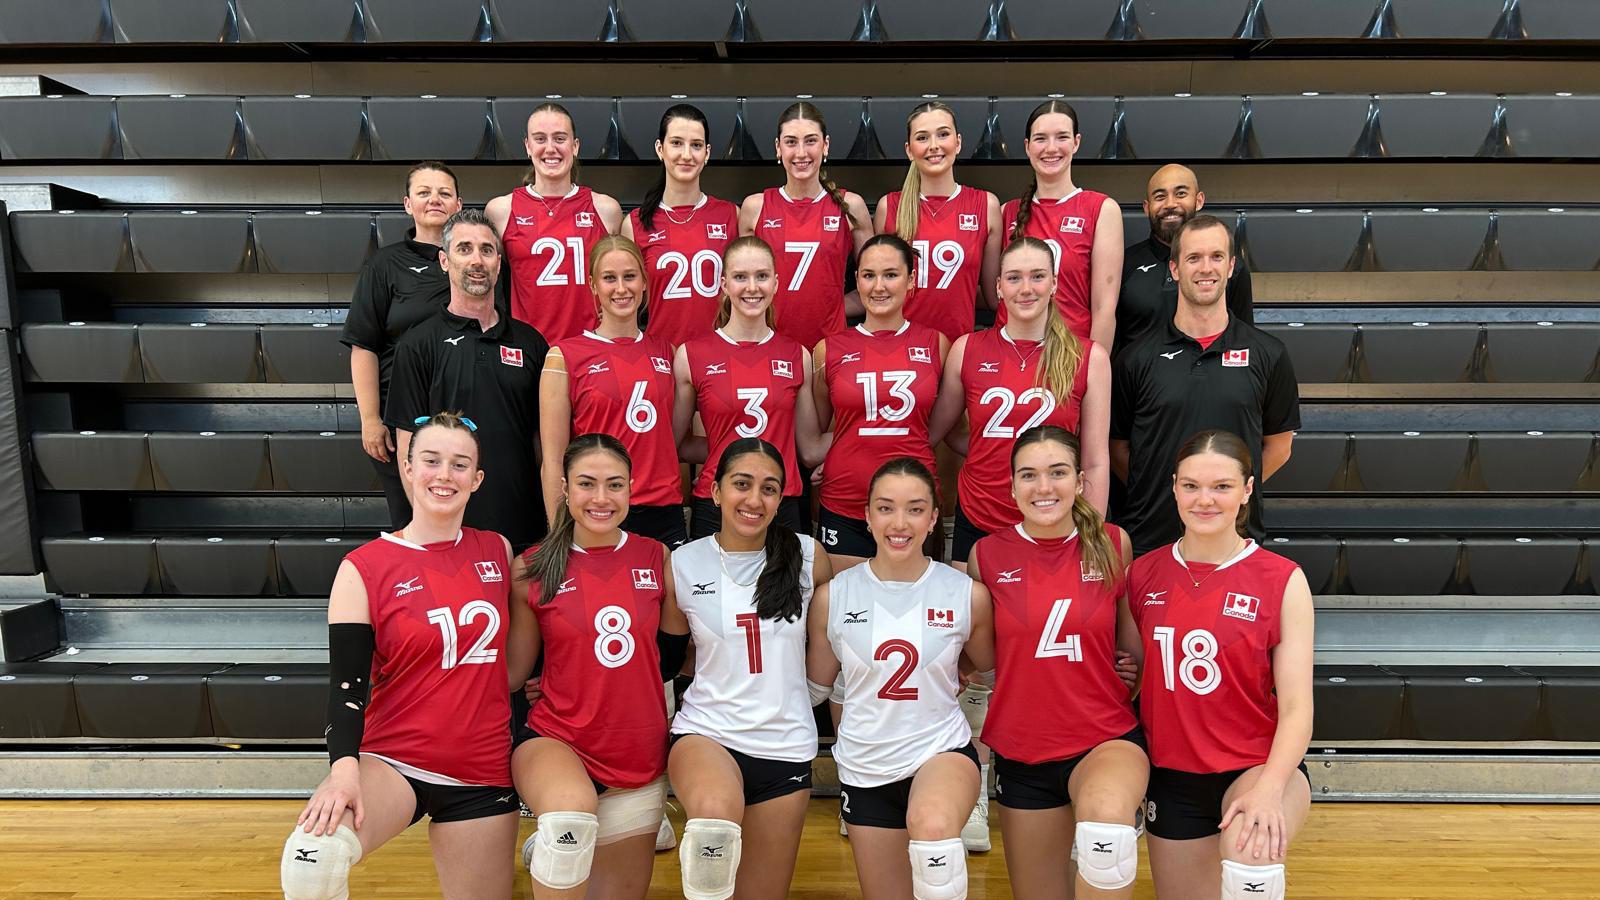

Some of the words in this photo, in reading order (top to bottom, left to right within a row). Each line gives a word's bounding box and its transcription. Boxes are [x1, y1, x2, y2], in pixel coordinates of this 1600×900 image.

[530, 236, 586, 286] 21
[656, 249, 724, 299] 20
[785, 241, 820, 291] 7
[912, 239, 966, 289] 19
[626, 381, 657, 433] 6
[735, 387, 769, 439] 3
[857, 371, 918, 422] 13
[980, 386, 1056, 438] 22
[821, 526, 839, 546] 13
[396, 585, 424, 598] Mizuno
[1224, 608, 1255, 620] Canada
[427, 589, 501, 669] 12
[594, 606, 635, 668] 8
[736, 612, 763, 675] 1
[927, 621, 954, 629] Canada
[1034, 598, 1083, 663] 4
[874, 638, 919, 701] 2
[1152, 626, 1222, 695] 18
[840, 790, 851, 813] 2
